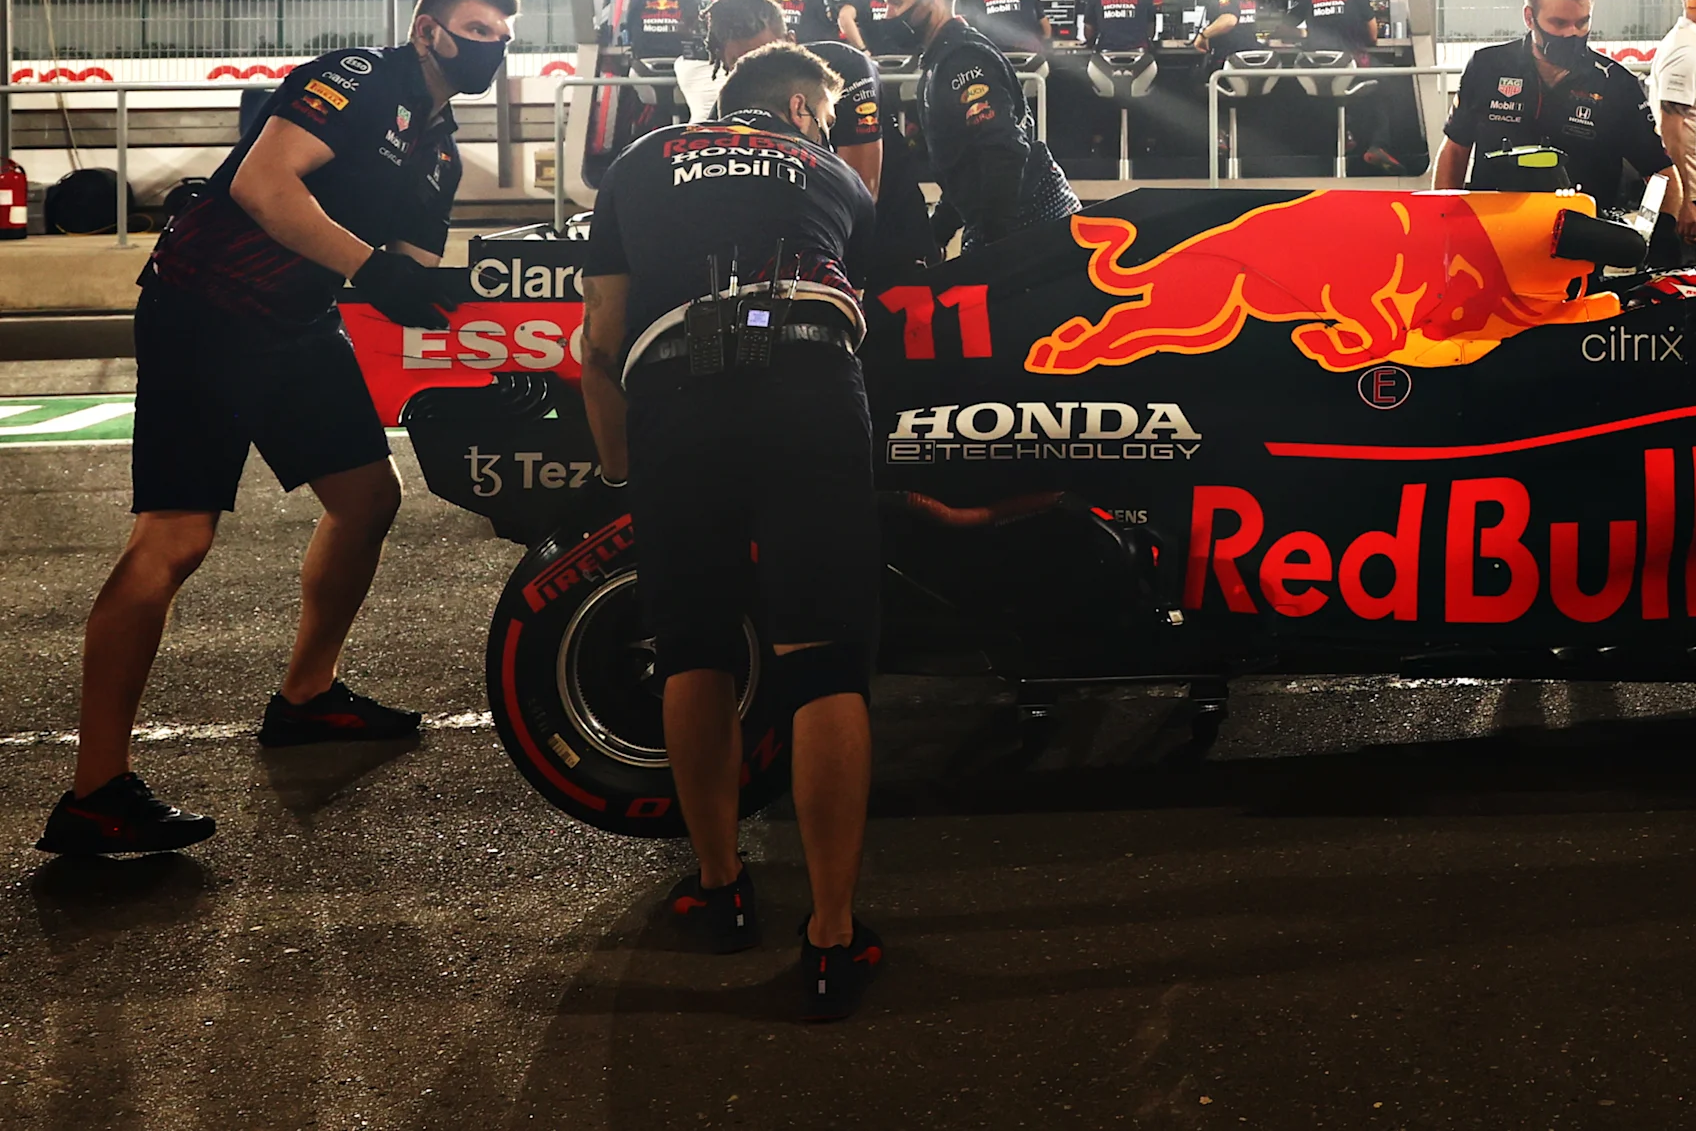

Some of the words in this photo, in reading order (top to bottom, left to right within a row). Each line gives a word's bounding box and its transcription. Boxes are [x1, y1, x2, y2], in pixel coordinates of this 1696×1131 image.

[986, 3, 1011, 14] Mobil
[1104, 10, 1126, 19] Mobil
[1313, 7, 1335, 17] Mobil
[643, 25, 668, 33] Mobil
[951, 65, 985, 91] citrix
[1488, 113, 1522, 123] ORACLE
[1490, 100, 1515, 111] Mobil
[1568, 116, 1594, 126] HONDA
[662, 134, 741, 158] Red
[748, 137, 817, 168] Bull
[671, 146, 805, 169] HONDA
[673, 159, 771, 186] Mobil
[877, 285, 993, 360] 11
[401, 319, 583, 370] ESS
[1582, 325, 1684, 362] citrix
[888, 402, 1202, 441] HONDA
[514, 451, 602, 490] Tez
[1180, 483, 1427, 622] Red
